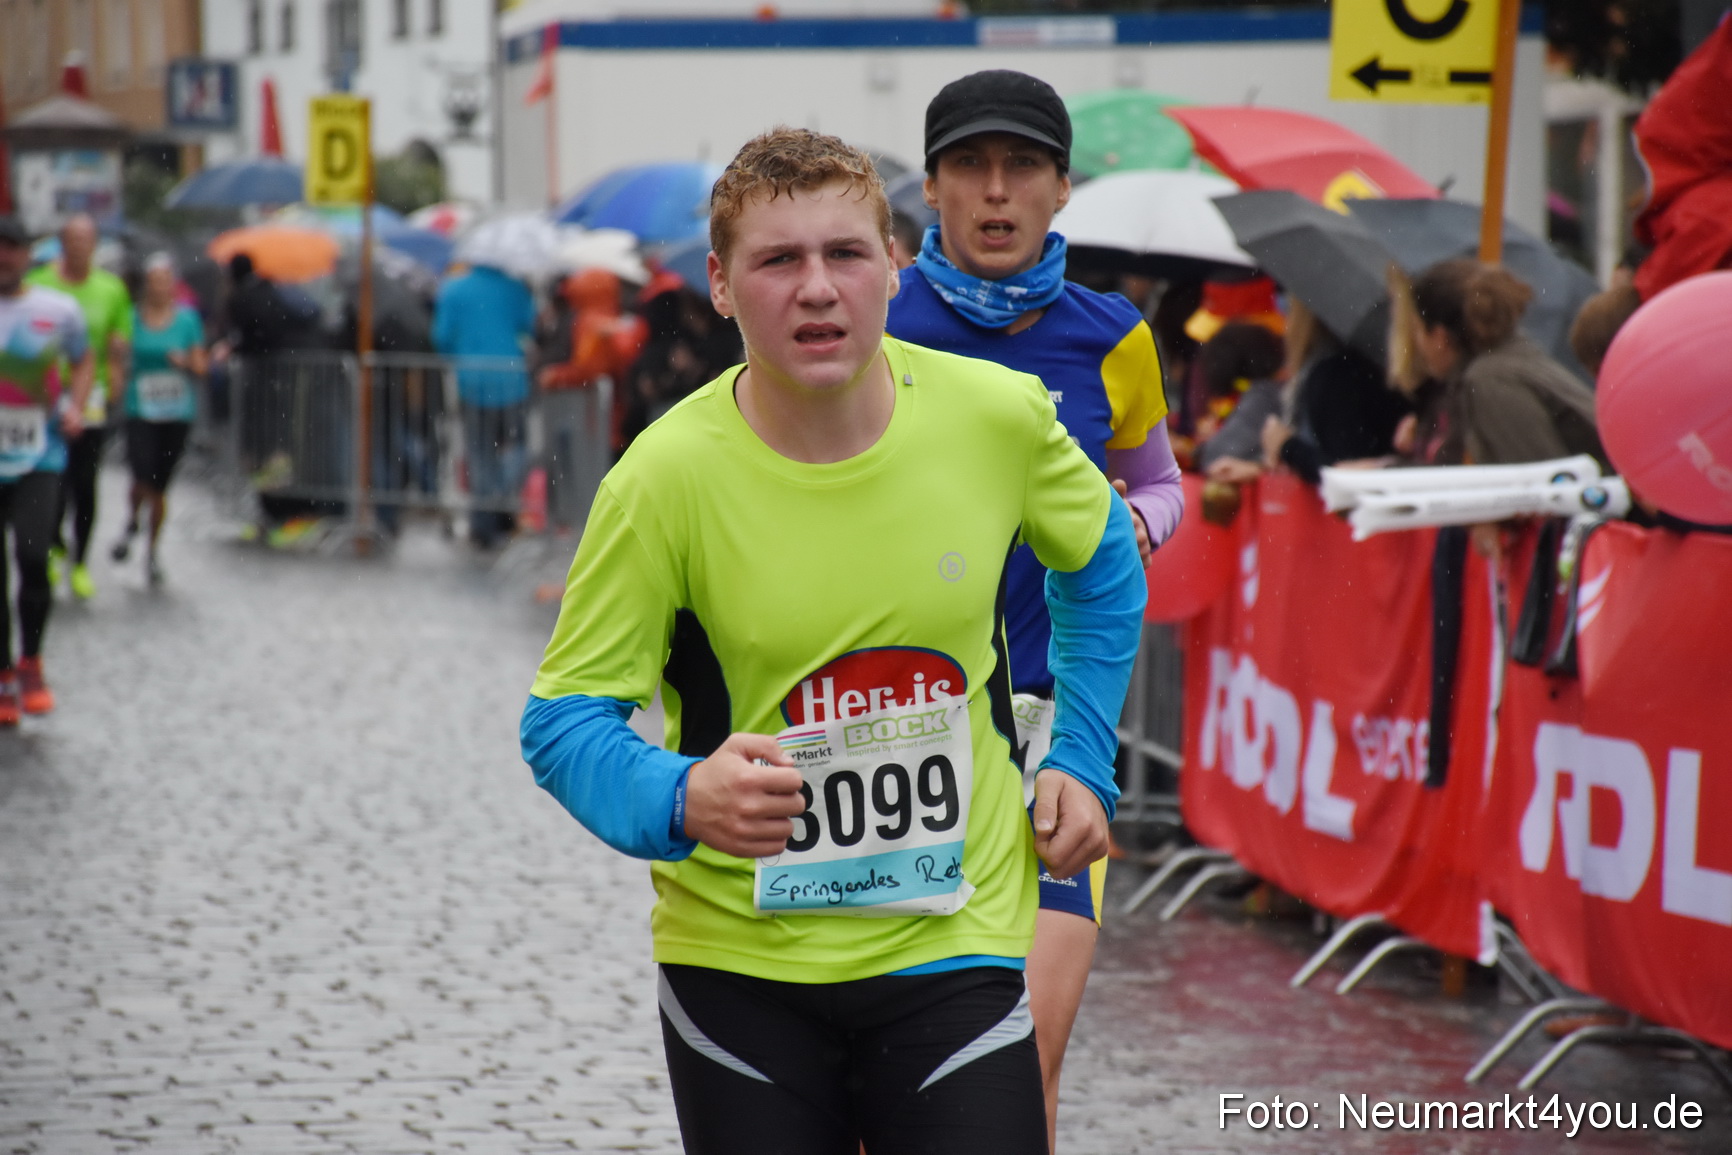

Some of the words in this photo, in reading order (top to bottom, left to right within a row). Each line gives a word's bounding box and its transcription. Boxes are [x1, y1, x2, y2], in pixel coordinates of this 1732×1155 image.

[321, 128, 356, 181] D
[844, 708, 951, 748] BOCK
[766, 868, 901, 905] Springendes
